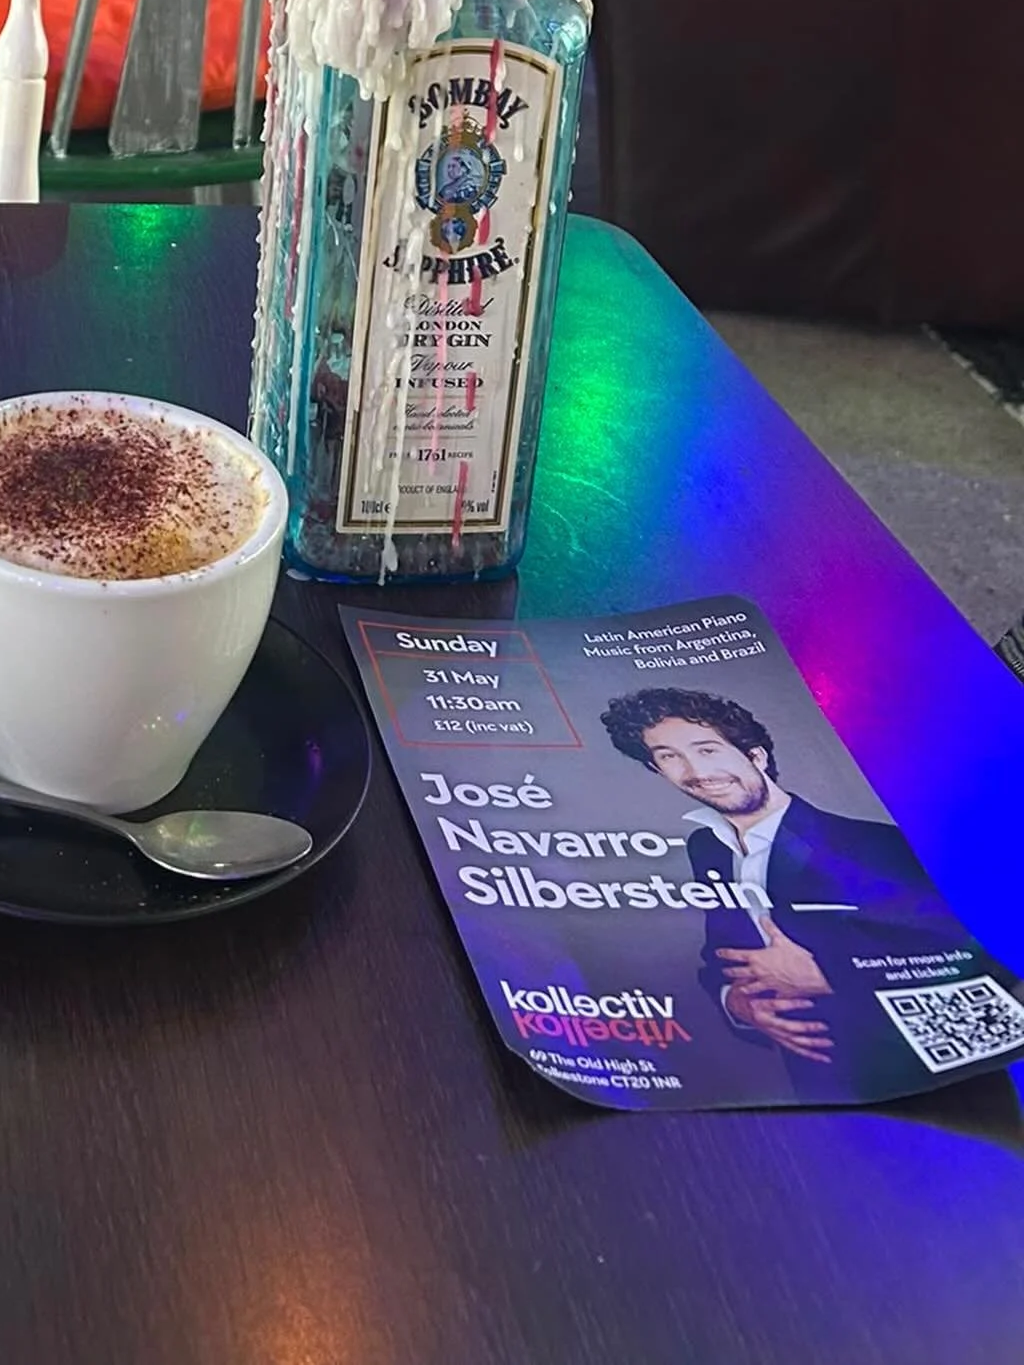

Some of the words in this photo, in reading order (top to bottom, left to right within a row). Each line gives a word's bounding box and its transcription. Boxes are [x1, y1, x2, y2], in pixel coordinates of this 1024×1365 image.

[446, 334, 493, 347] GIN
[417, 448, 447, 462] 1761
[425, 484, 435, 494] OF
[584, 632, 625, 644] Latin
[627, 621, 702, 641] American
[701, 612, 747, 629] Piano
[396, 631, 498, 658] Sunday
[583, 645, 632, 658] Music
[633, 642, 673, 655] from
[675, 628, 757, 651] Argentina,
[633, 656, 687, 670] Bolivia
[689, 650, 719, 665] and
[720, 641, 767, 661] Brazil
[423, 669, 449, 683] 31
[450, 669, 500, 689] May
[426, 694, 521, 711] 11:30am
[433, 719, 463, 732] £12
[465, 719, 497, 733] (inc
[499, 721, 534, 735] vat)
[420, 772, 553, 809] José
[437, 816, 687, 858] Navarro-
[458, 864, 774, 909] Silberstein
[852, 956, 887, 969] Scan
[886, 955, 907, 966] for
[908, 954, 944, 966] more
[943, 949, 973, 962] info
[885, 968, 912, 981] and
[911, 966, 960, 979] tickets
[500, 979, 673, 1019] kollectiv
[547, 1051, 576, 1067] The
[576, 1056, 604, 1070] Old
[604, 1058, 638, 1075] High
[639, 1059, 657, 1073] St
[610, 1074, 650, 1089] CT20
[651, 1076, 683, 1089] 1NR
